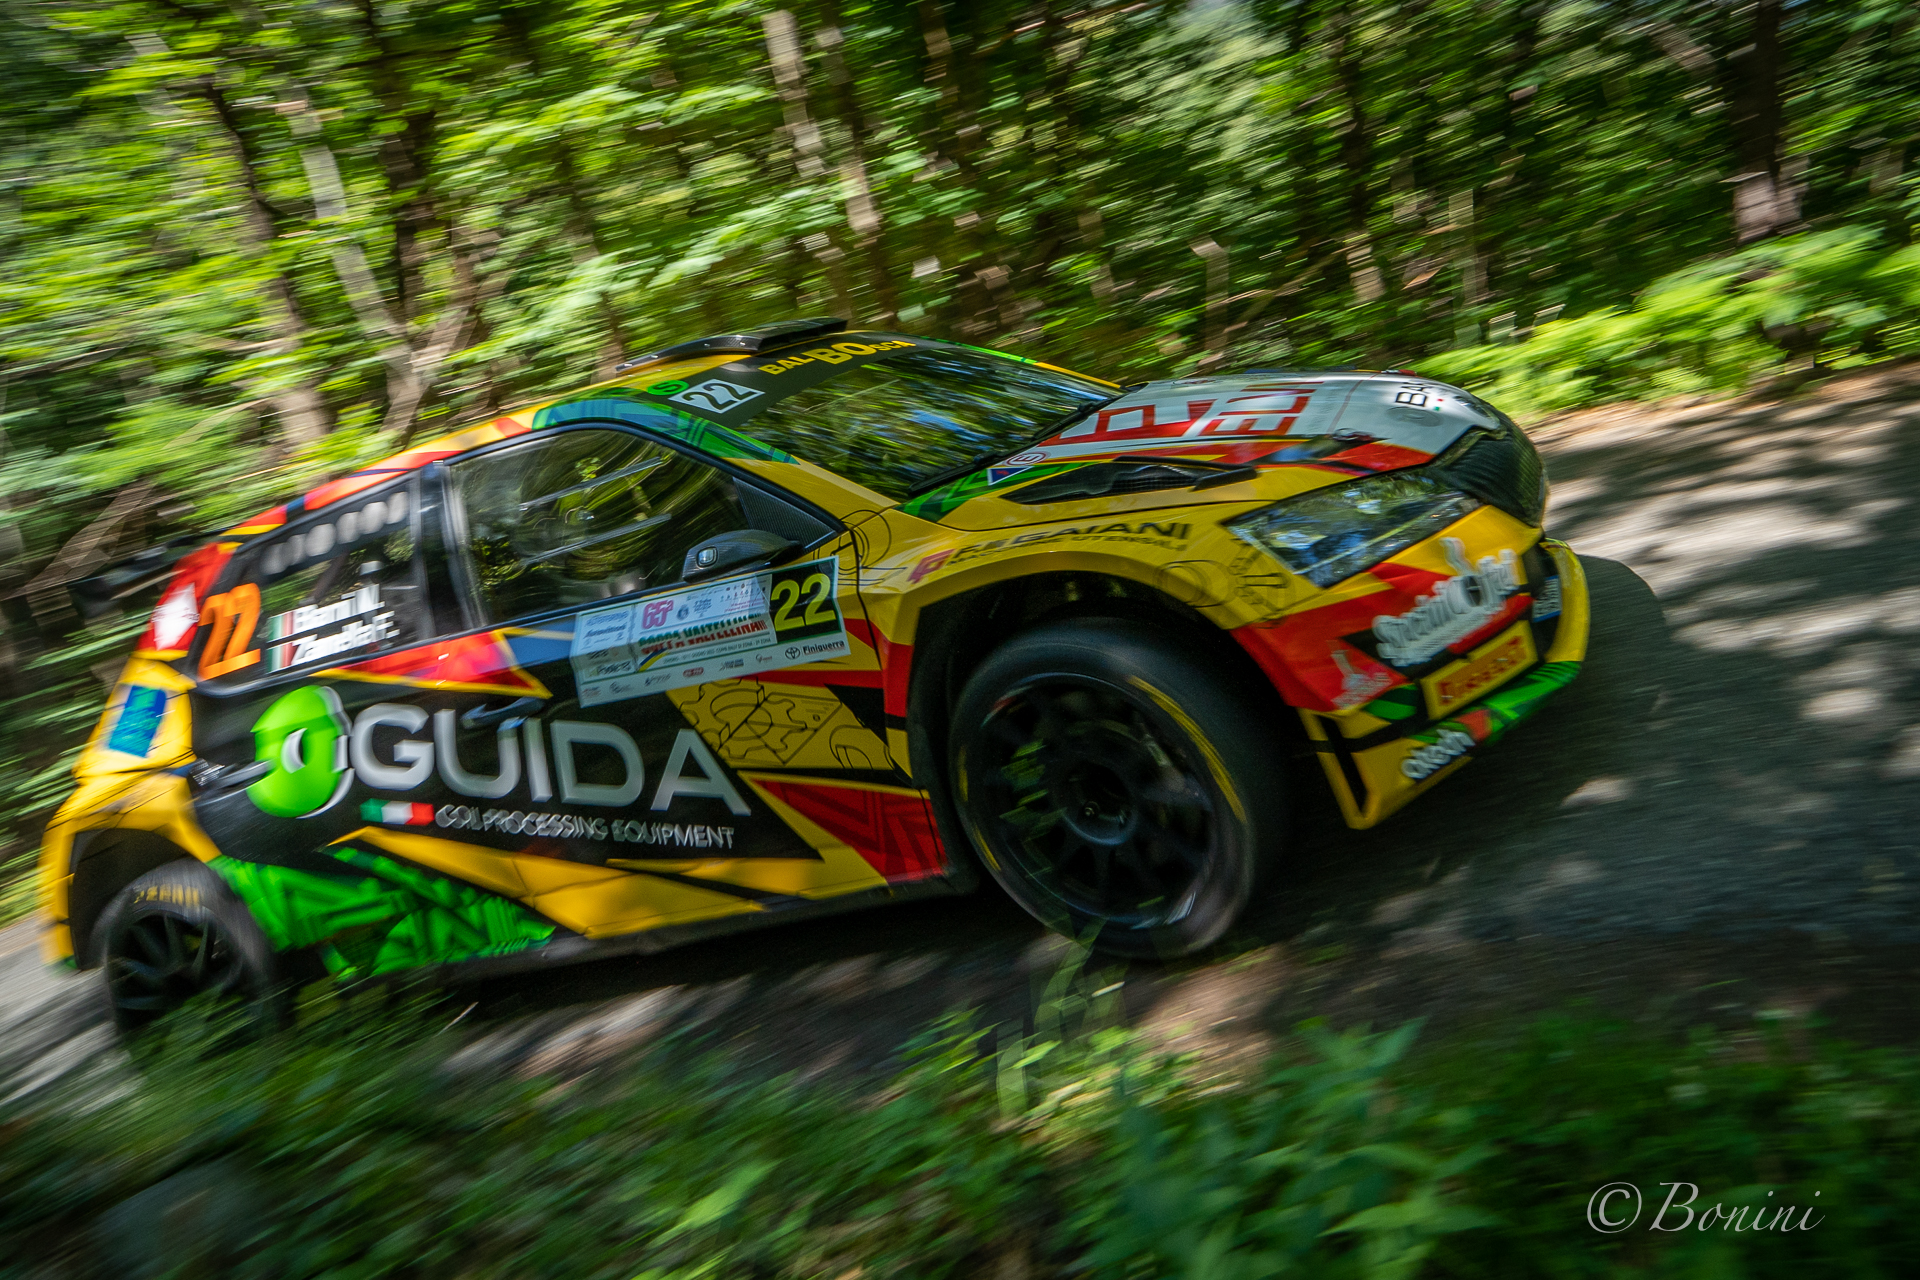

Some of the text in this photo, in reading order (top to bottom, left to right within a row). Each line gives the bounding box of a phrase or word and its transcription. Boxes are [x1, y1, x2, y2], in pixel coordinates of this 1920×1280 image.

[758, 340, 917, 375] BALBOSCA
[681, 382, 759, 410] 22
[770, 572, 837, 632] 22
[197, 583, 262, 682] 22
[802, 640, 846, 656] Finiguerra
[349, 702, 752, 817] GUIDA
[482, 808, 609, 841] PROCESSING
[611, 818, 735, 849] EQUIPMENT
